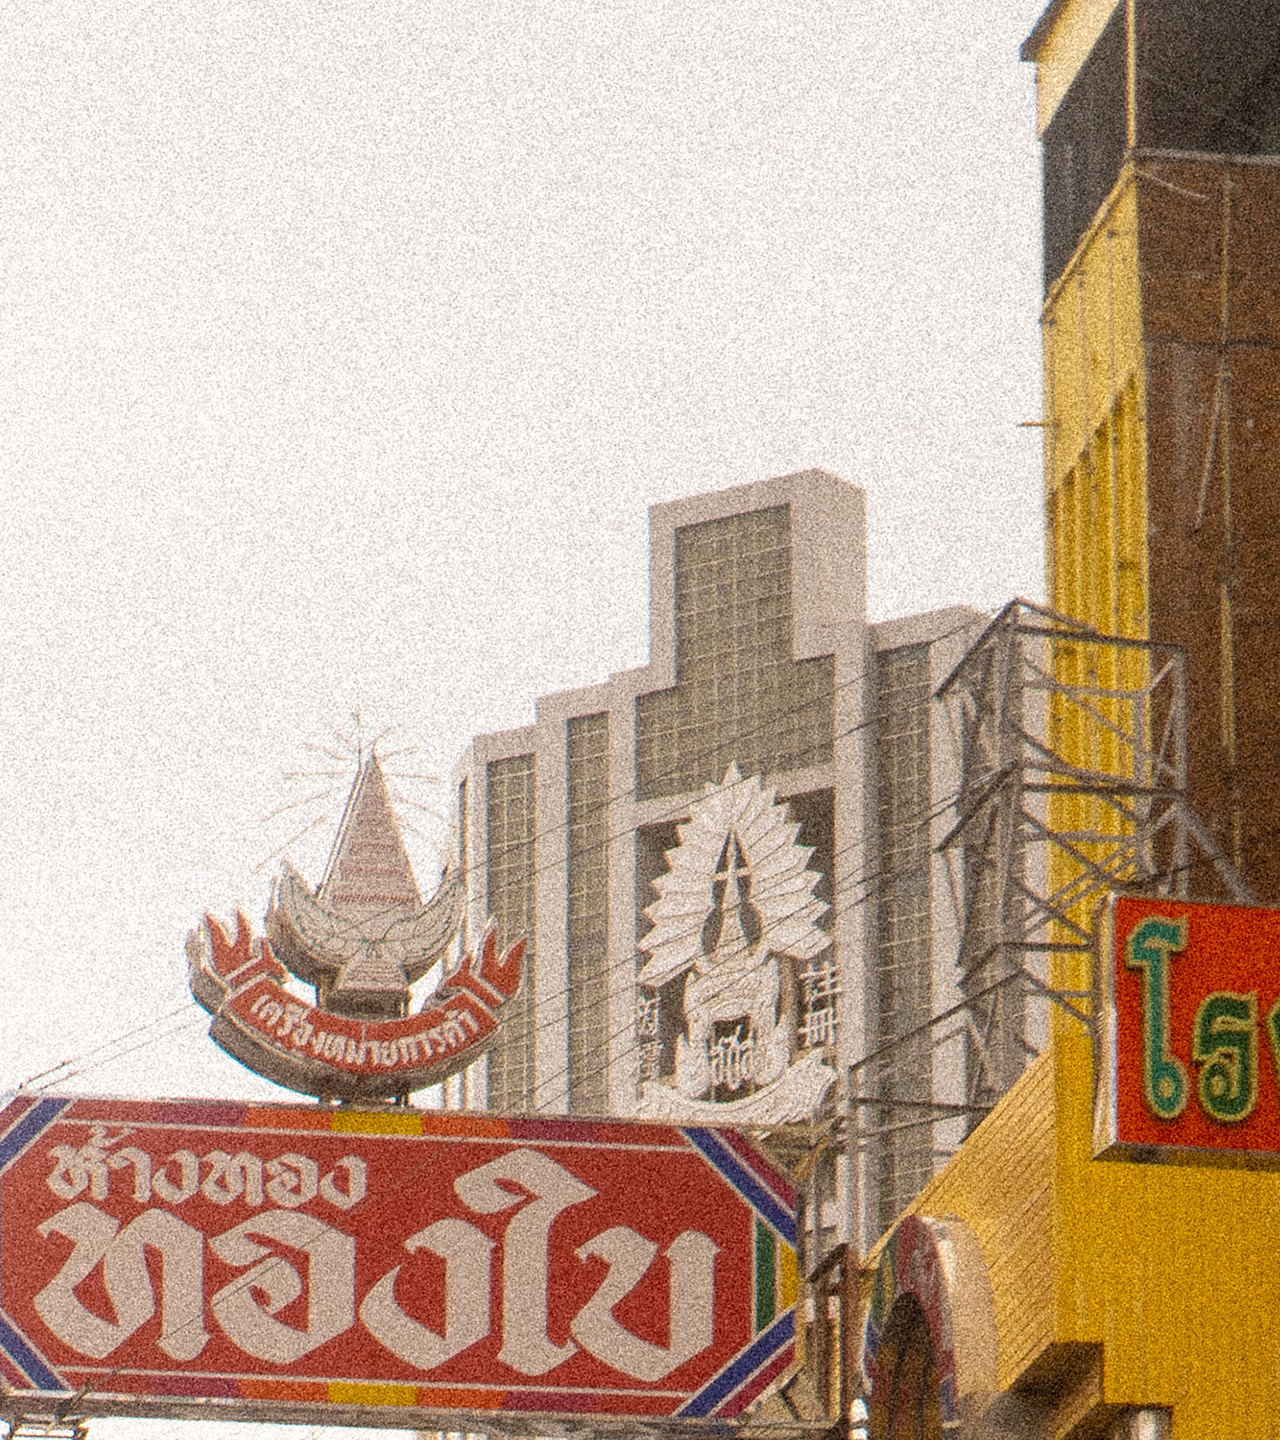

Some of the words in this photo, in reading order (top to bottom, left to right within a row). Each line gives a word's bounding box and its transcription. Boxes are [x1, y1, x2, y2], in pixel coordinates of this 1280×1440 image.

[1126, 914, 1280, 1122] โร
[32, 1147, 722, 1383] ทองใบ
[44, 1124, 368, 1210] ห้างทอง
